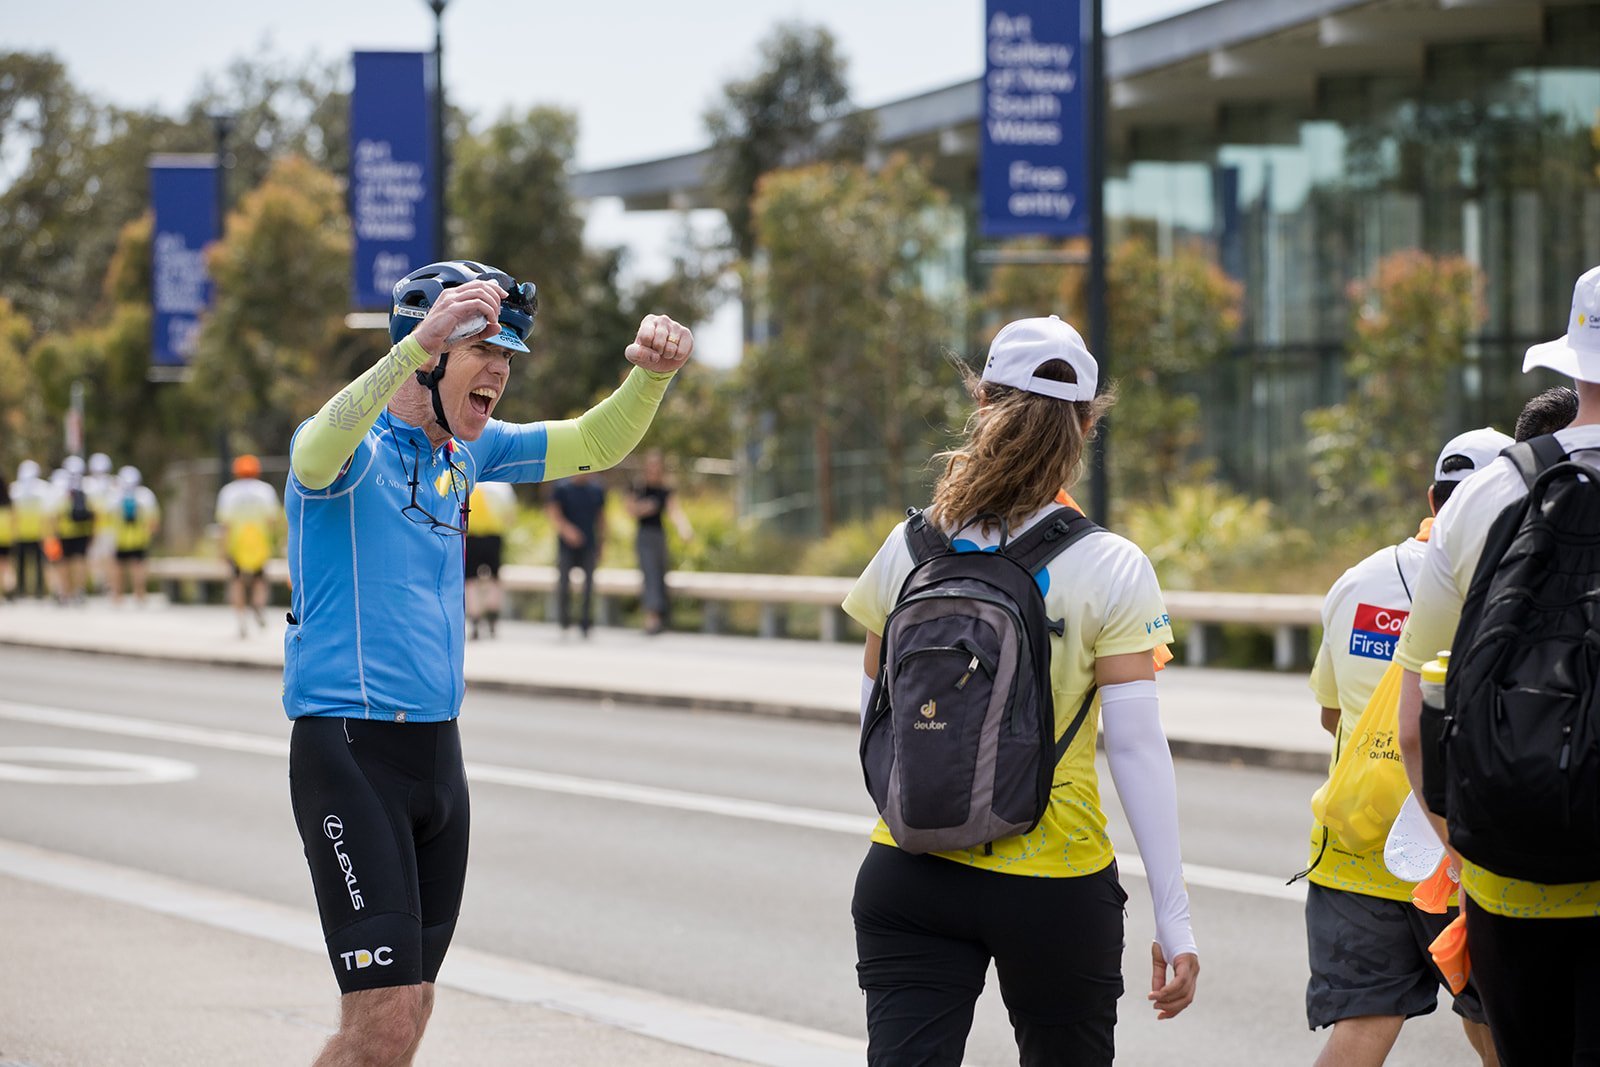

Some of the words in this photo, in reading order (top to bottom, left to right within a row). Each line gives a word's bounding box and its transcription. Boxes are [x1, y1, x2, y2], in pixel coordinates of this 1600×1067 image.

[989, 12, 1031, 38] Art
[988, 41, 1072, 68] Gallery
[987, 68, 1014, 91] of
[1019, 69, 1074, 92] New
[988, 94, 1060, 119] South
[987, 119, 1062, 145] Wales
[1009, 161, 1067, 190] Free
[1008, 191, 1075, 220] entry
[1145, 614, 1171, 634] VER
[1352, 633, 1391, 657] First
[913, 721, 947, 730] deuter
[333, 840, 365, 911] LEXUS
[340, 946, 394, 971] TDC
